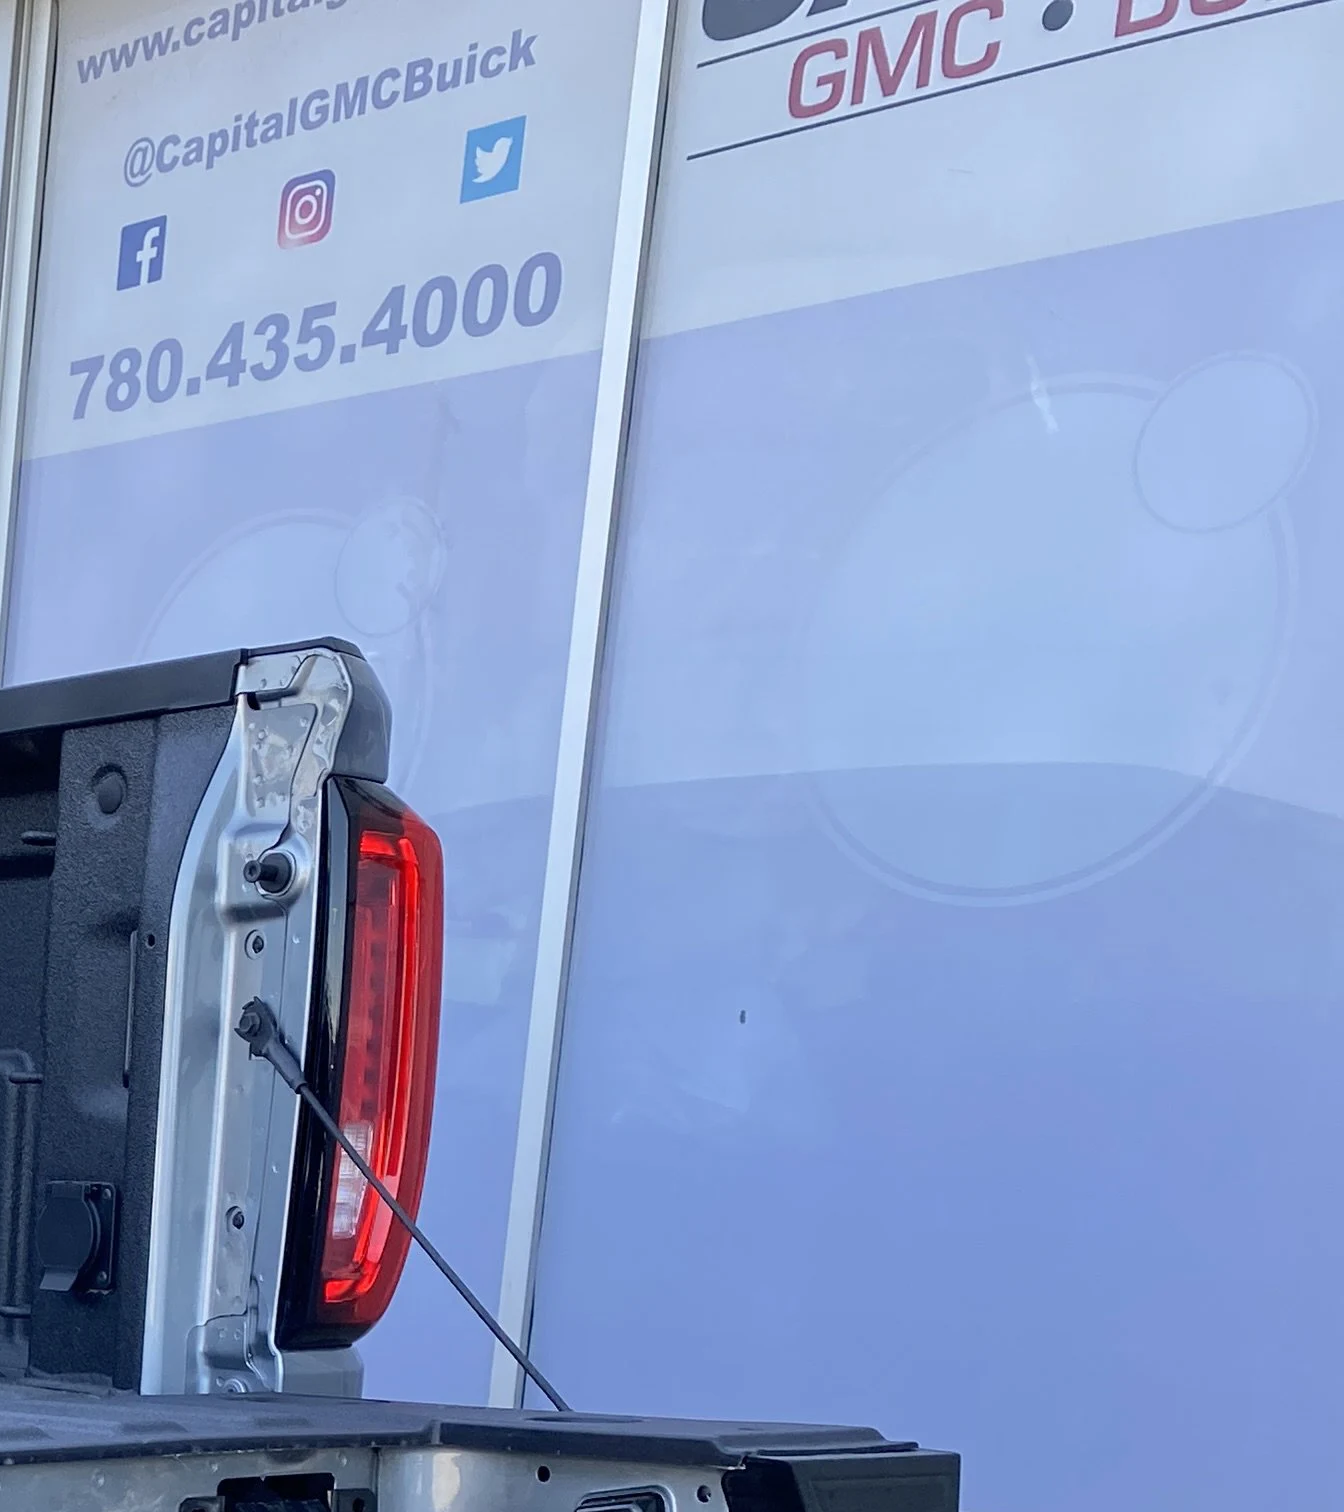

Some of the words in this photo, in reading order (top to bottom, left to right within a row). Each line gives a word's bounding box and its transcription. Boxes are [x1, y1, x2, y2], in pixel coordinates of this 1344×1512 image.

[77, 0, 348, 84] www.capi
[124, 28, 538, 188] @CapitalGMCBuick
[788, 0, 1005, 119] GMC
[69, 251, 563, 421] 780.435.4000
